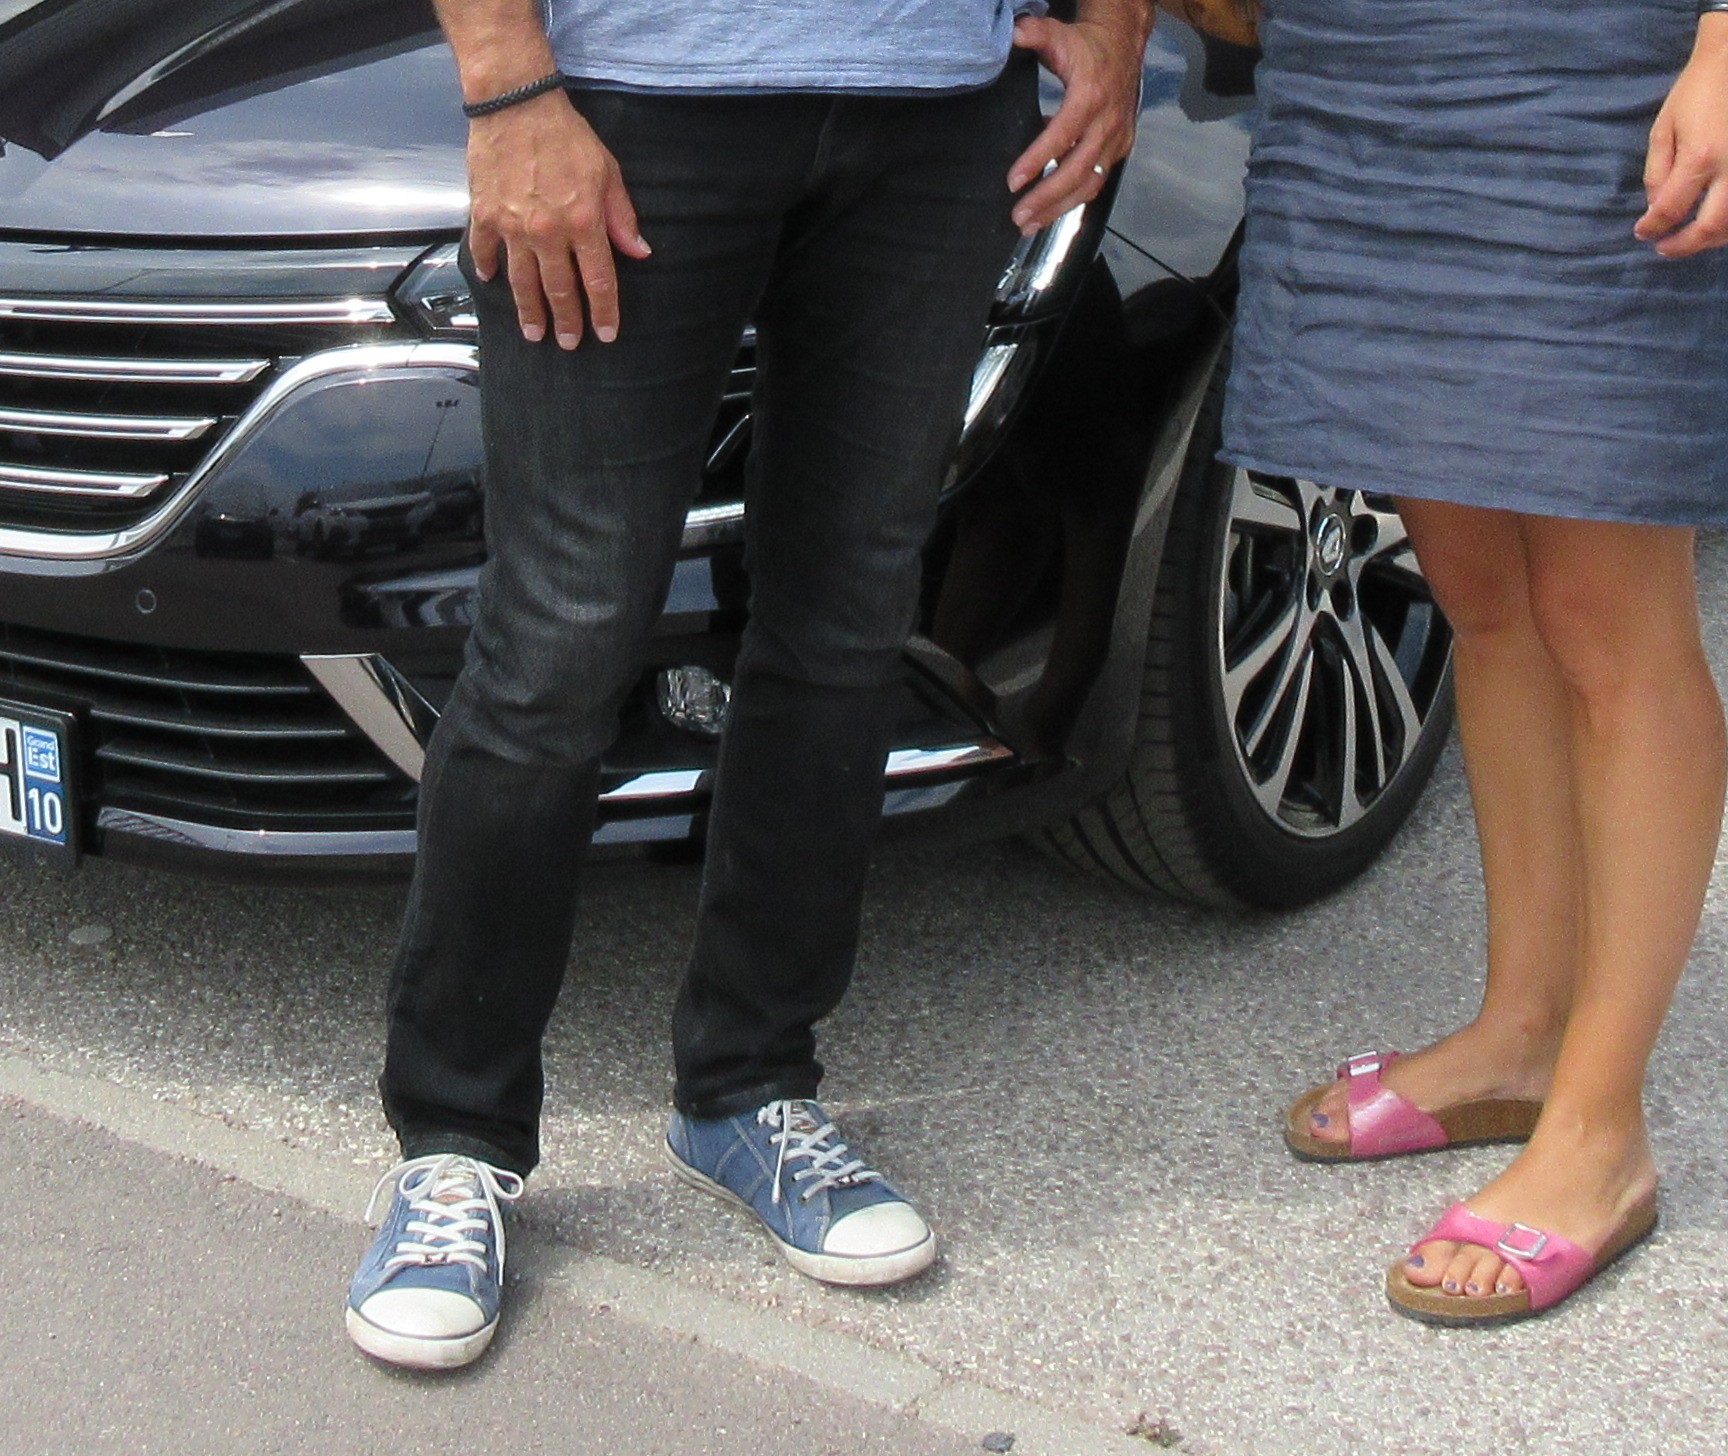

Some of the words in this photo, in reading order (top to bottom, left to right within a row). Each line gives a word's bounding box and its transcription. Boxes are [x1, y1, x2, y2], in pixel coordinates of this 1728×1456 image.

[26, 735, 56, 751] Grand
[27, 746, 56, 771] Est
[27, 787, 63, 835] 10
